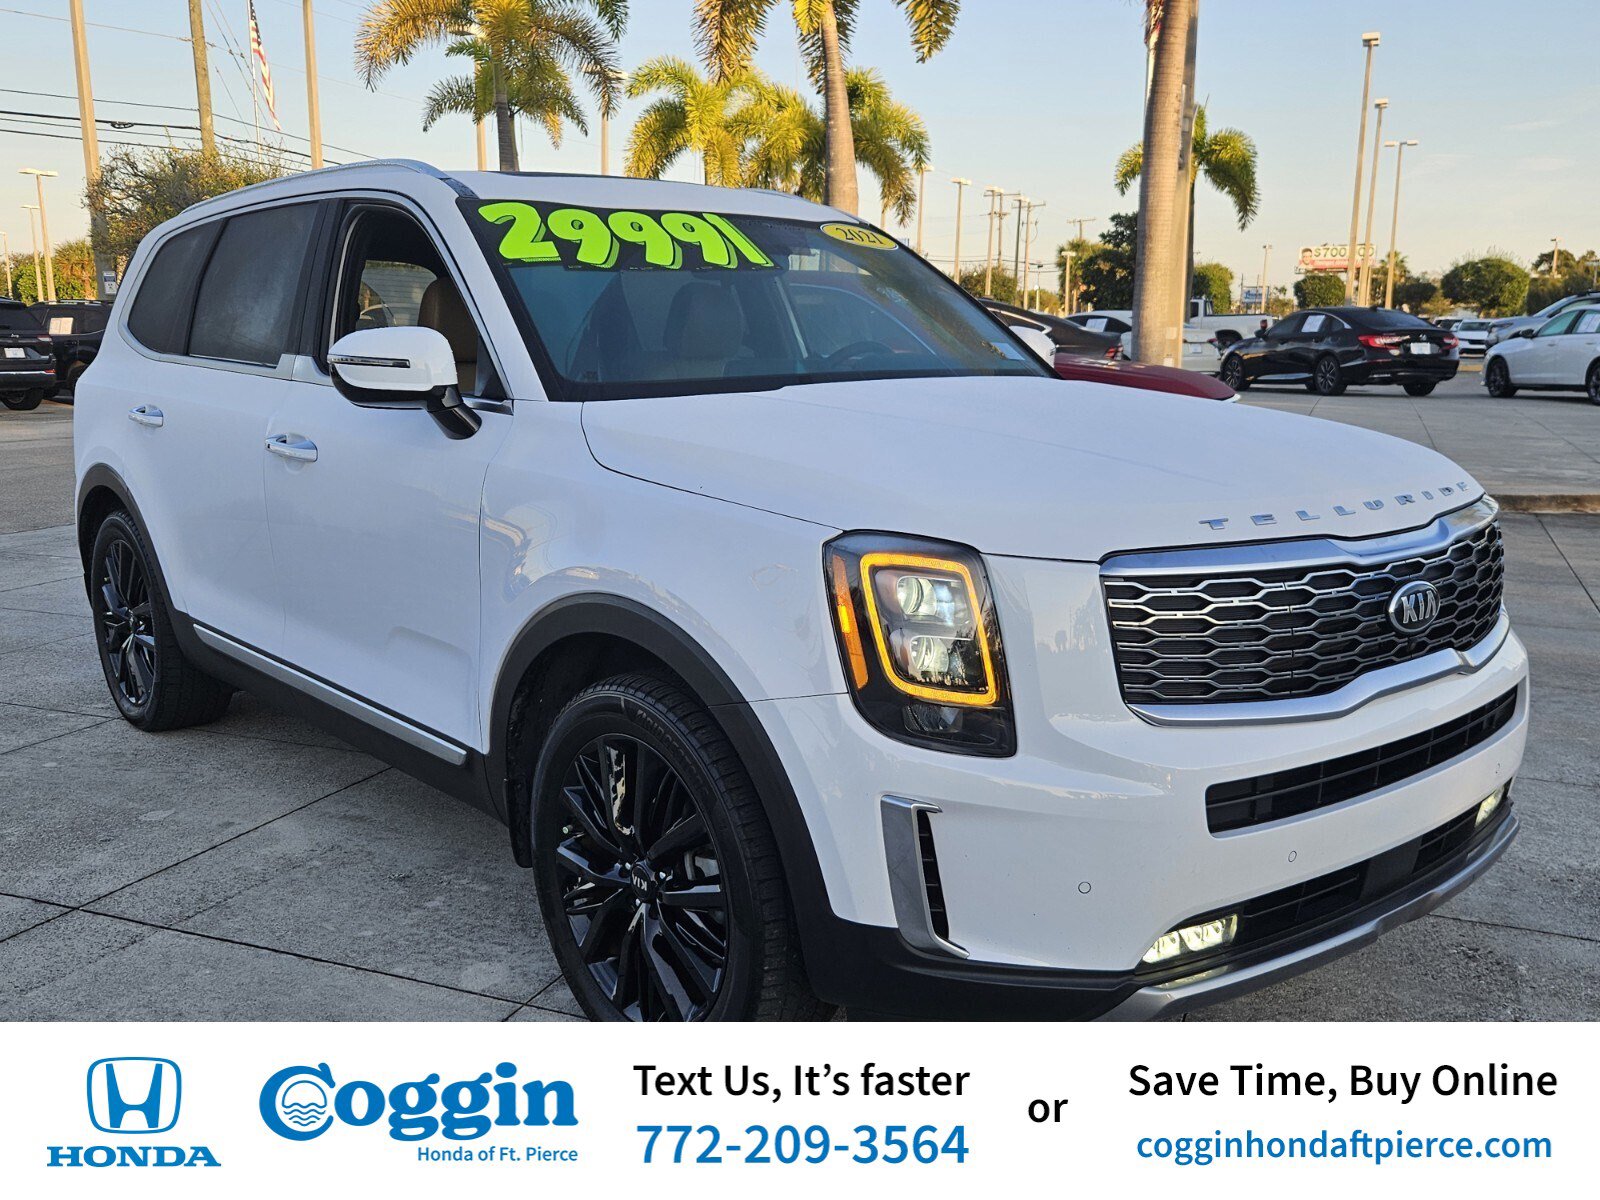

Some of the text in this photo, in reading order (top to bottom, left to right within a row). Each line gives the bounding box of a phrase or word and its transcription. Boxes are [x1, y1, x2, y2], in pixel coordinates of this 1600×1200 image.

[478, 202, 774, 269] 29991
[836, 227, 884, 245] 2021
[1199, 481, 1470, 530] TELLURIDE
[1401, 590, 1436, 623] KIA
